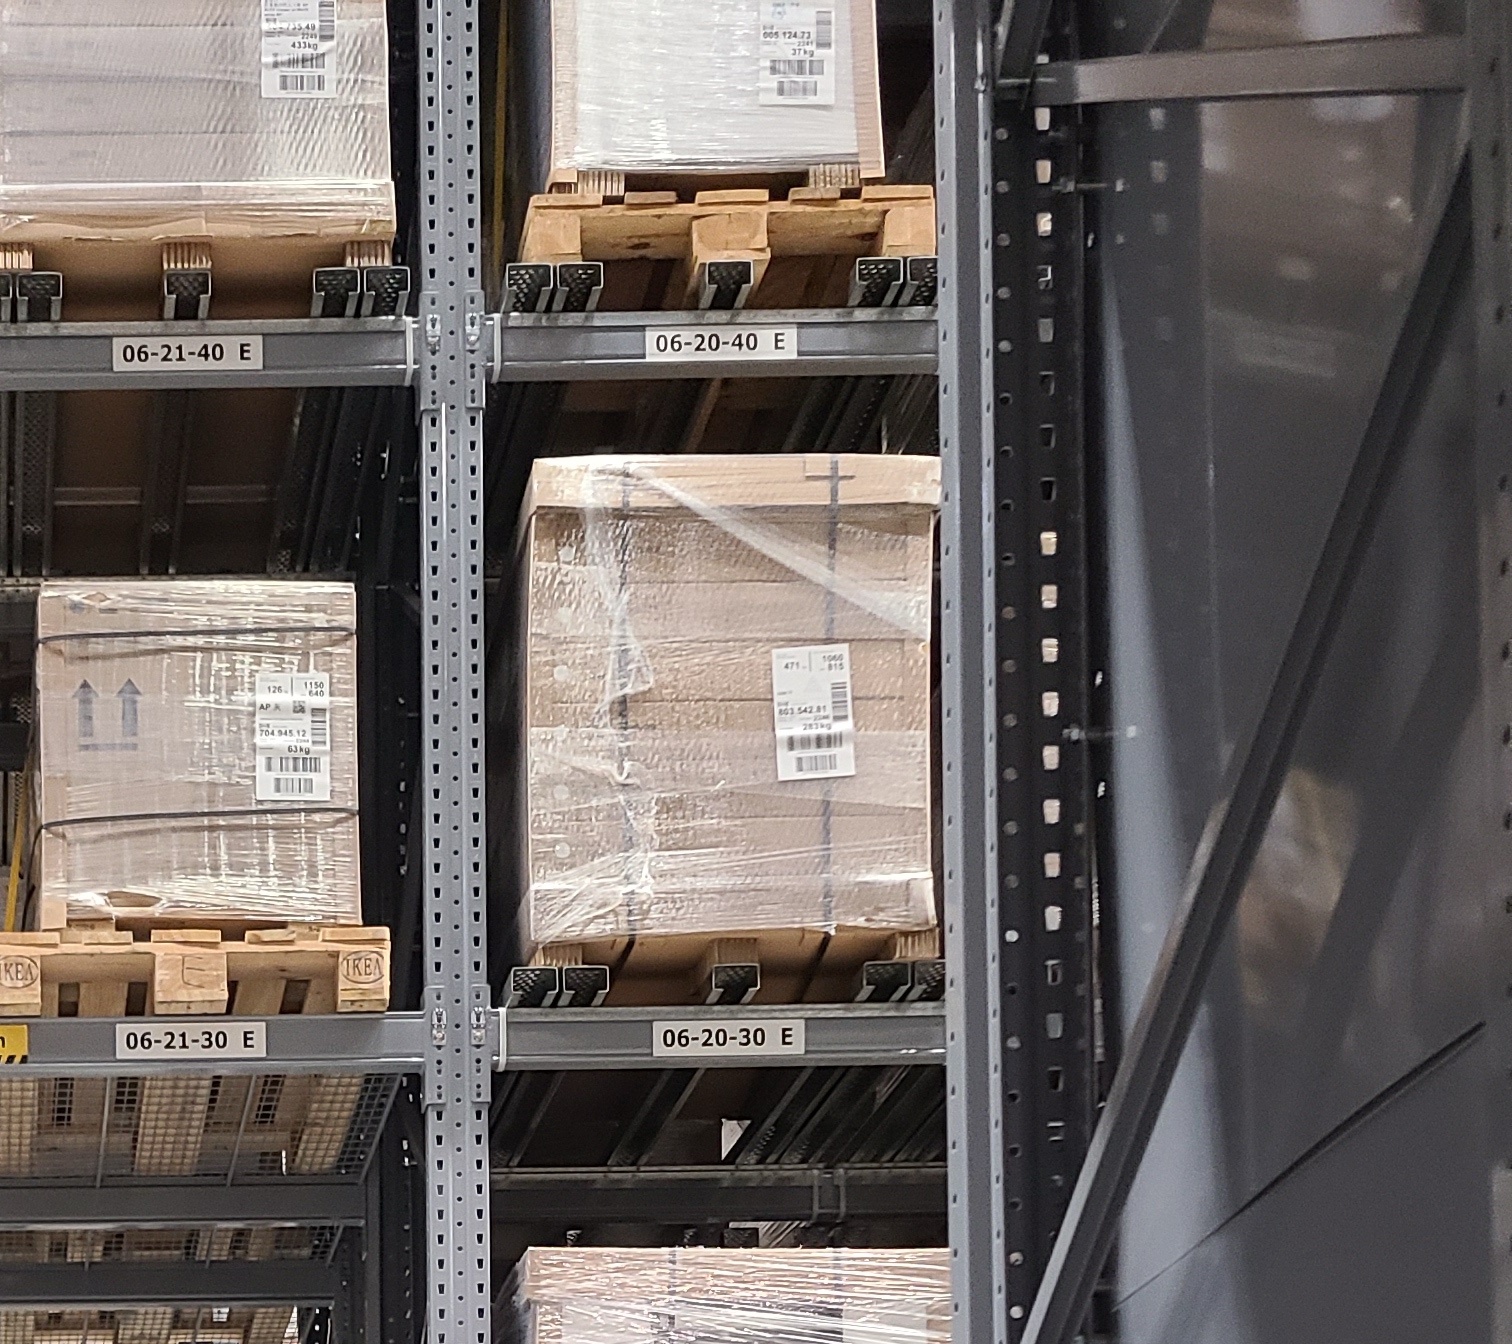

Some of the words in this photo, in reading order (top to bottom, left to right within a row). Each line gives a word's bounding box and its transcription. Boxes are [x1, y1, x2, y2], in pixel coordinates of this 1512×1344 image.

[655, 334, 759, 353] 06-20-40
[773, 334, 786, 352] E
[122, 344, 225, 363] 06-21-40
[238, 344, 252, 362] E
[267, 686, 283, 694] 126
[304, 681, 325, 690] 1150
[259, 729, 307, 738] 704.945.12
[341, 955, 384, 977] IKEA
[125, 1030, 229, 1051] 06-21-30
[242, 1031, 255, 1049] E
[662, 1028, 766, 1048] 06-20-30
[781, 1029, 793, 1046] E
